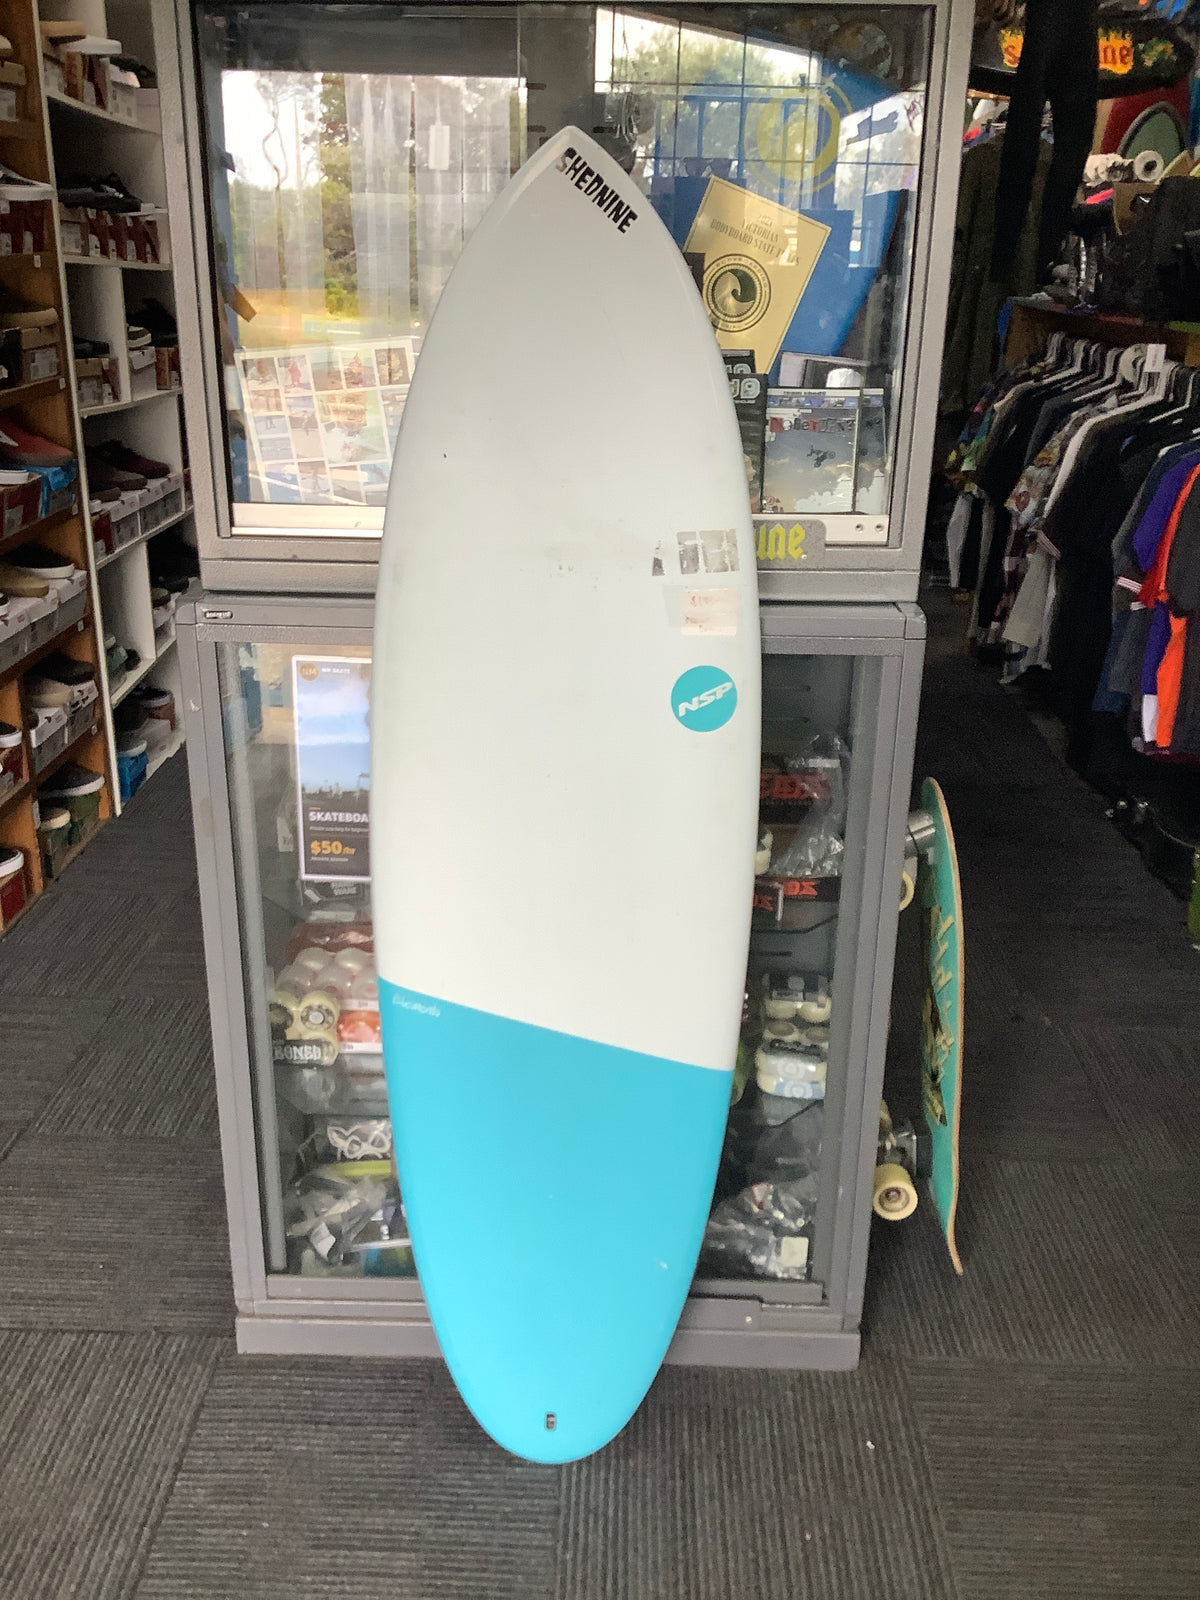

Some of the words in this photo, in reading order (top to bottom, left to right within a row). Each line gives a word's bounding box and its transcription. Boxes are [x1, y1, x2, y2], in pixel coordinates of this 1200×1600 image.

[556, 147, 638, 233] SHEDNINE
[711, 219, 754, 245] BODYBOARD
[678, 681, 733, 717] NSP
